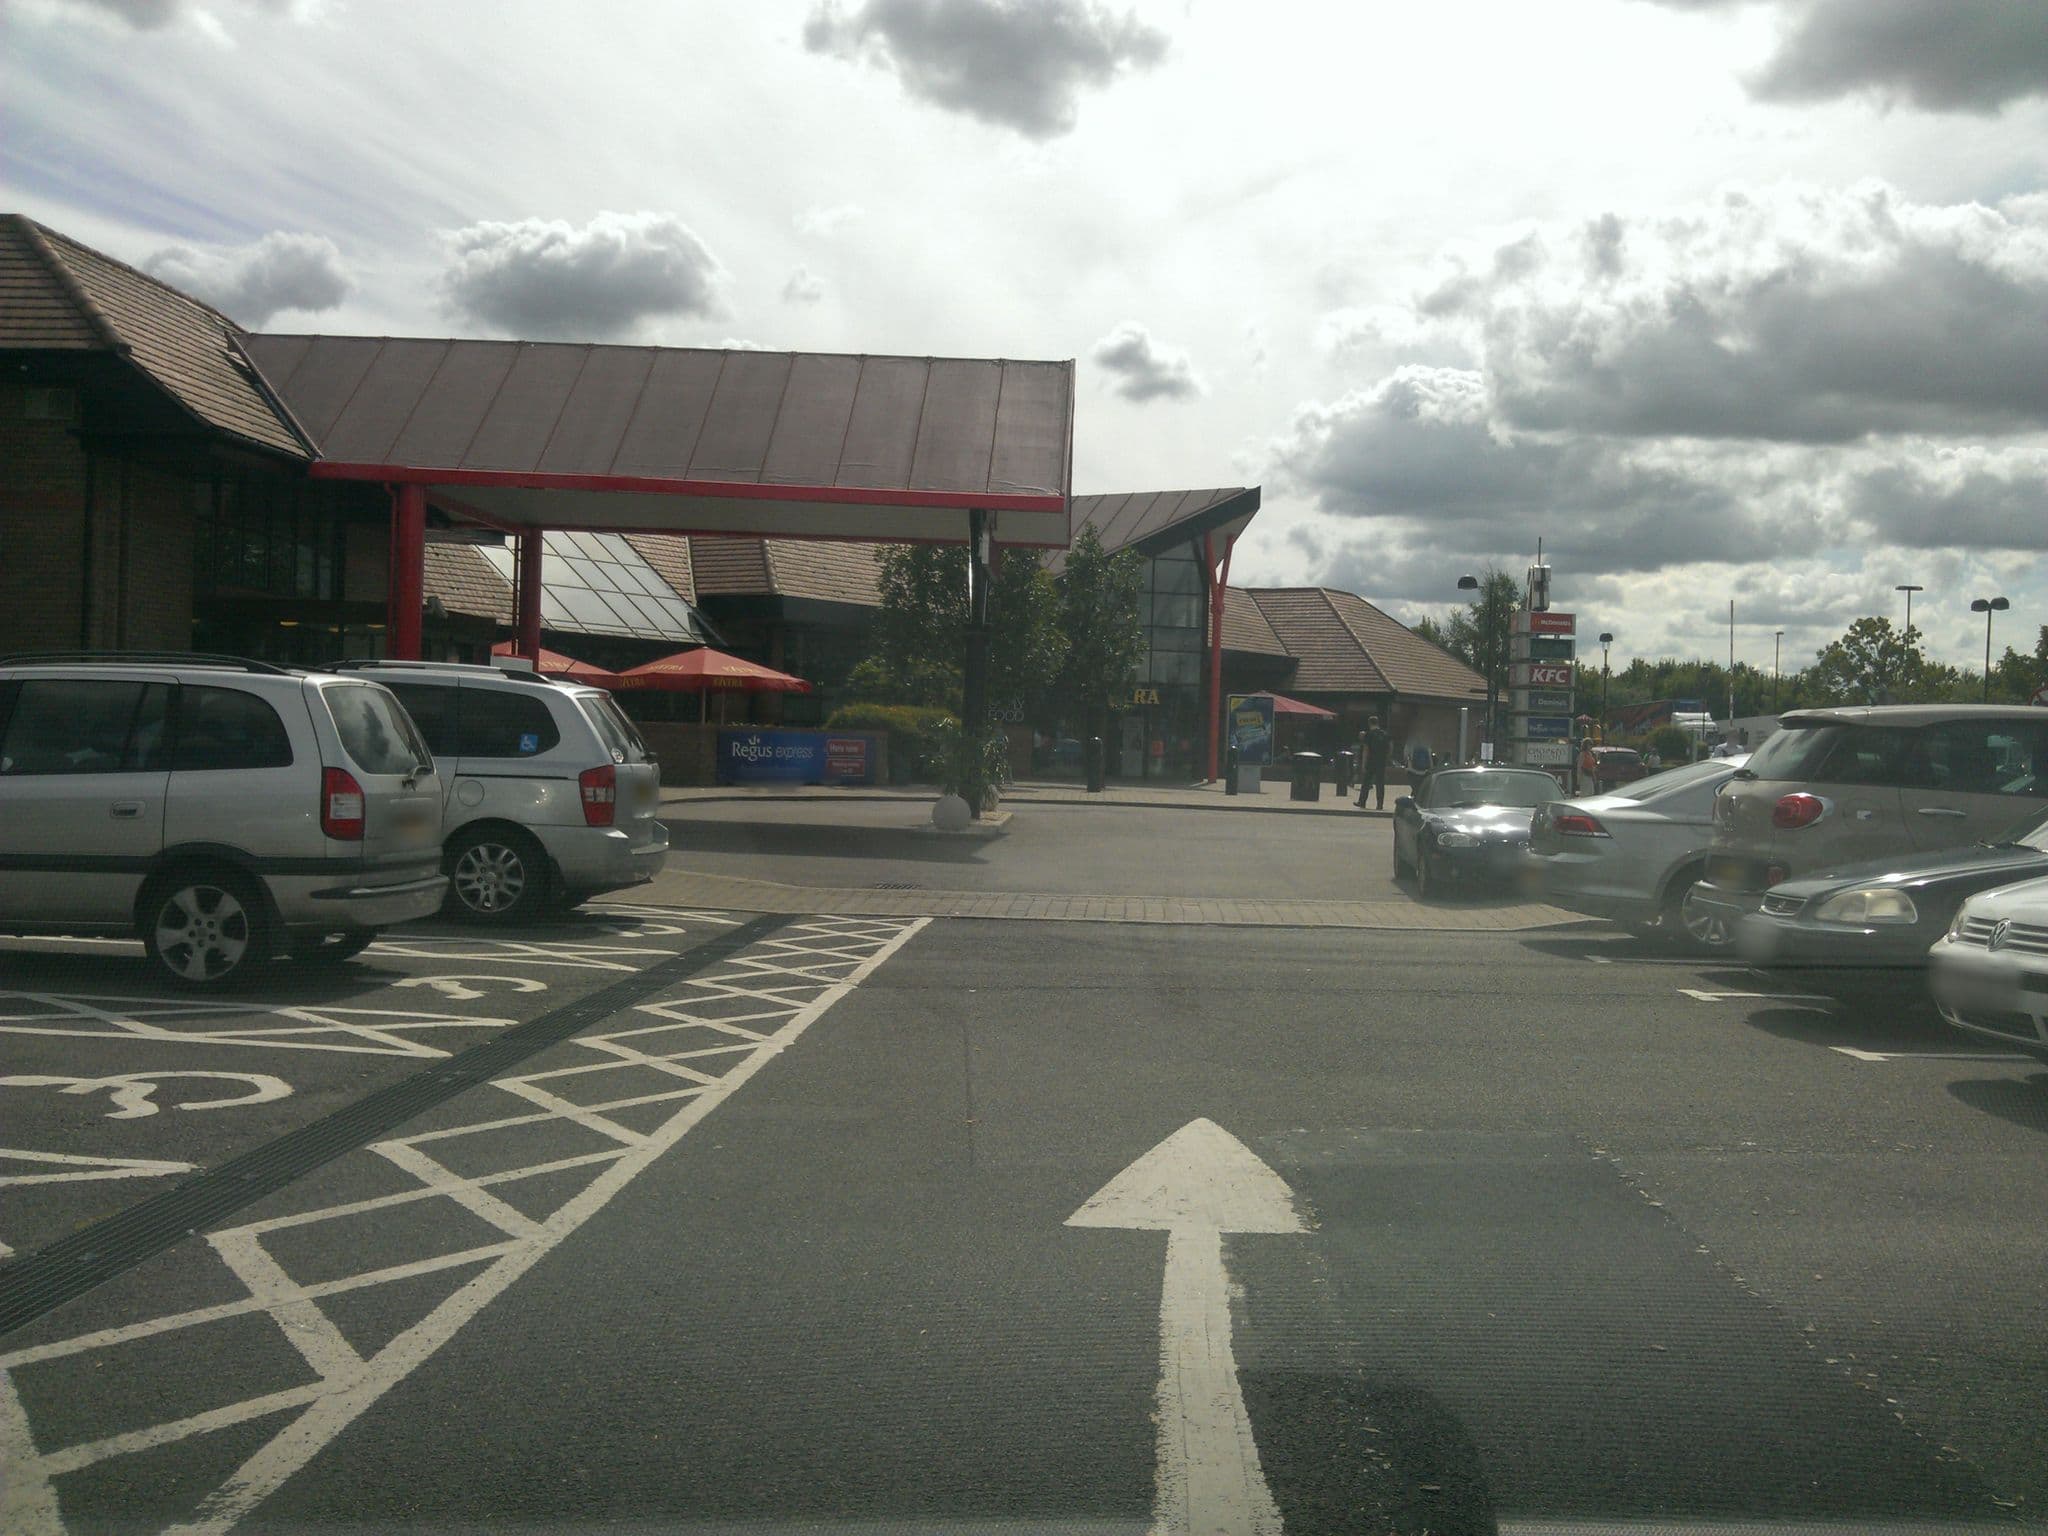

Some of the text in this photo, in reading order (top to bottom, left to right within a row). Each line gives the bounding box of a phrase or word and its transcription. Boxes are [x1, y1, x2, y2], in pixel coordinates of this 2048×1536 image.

[1531, 668, 1568, 683] KFC
[732, 741, 814, 762] Regus express
